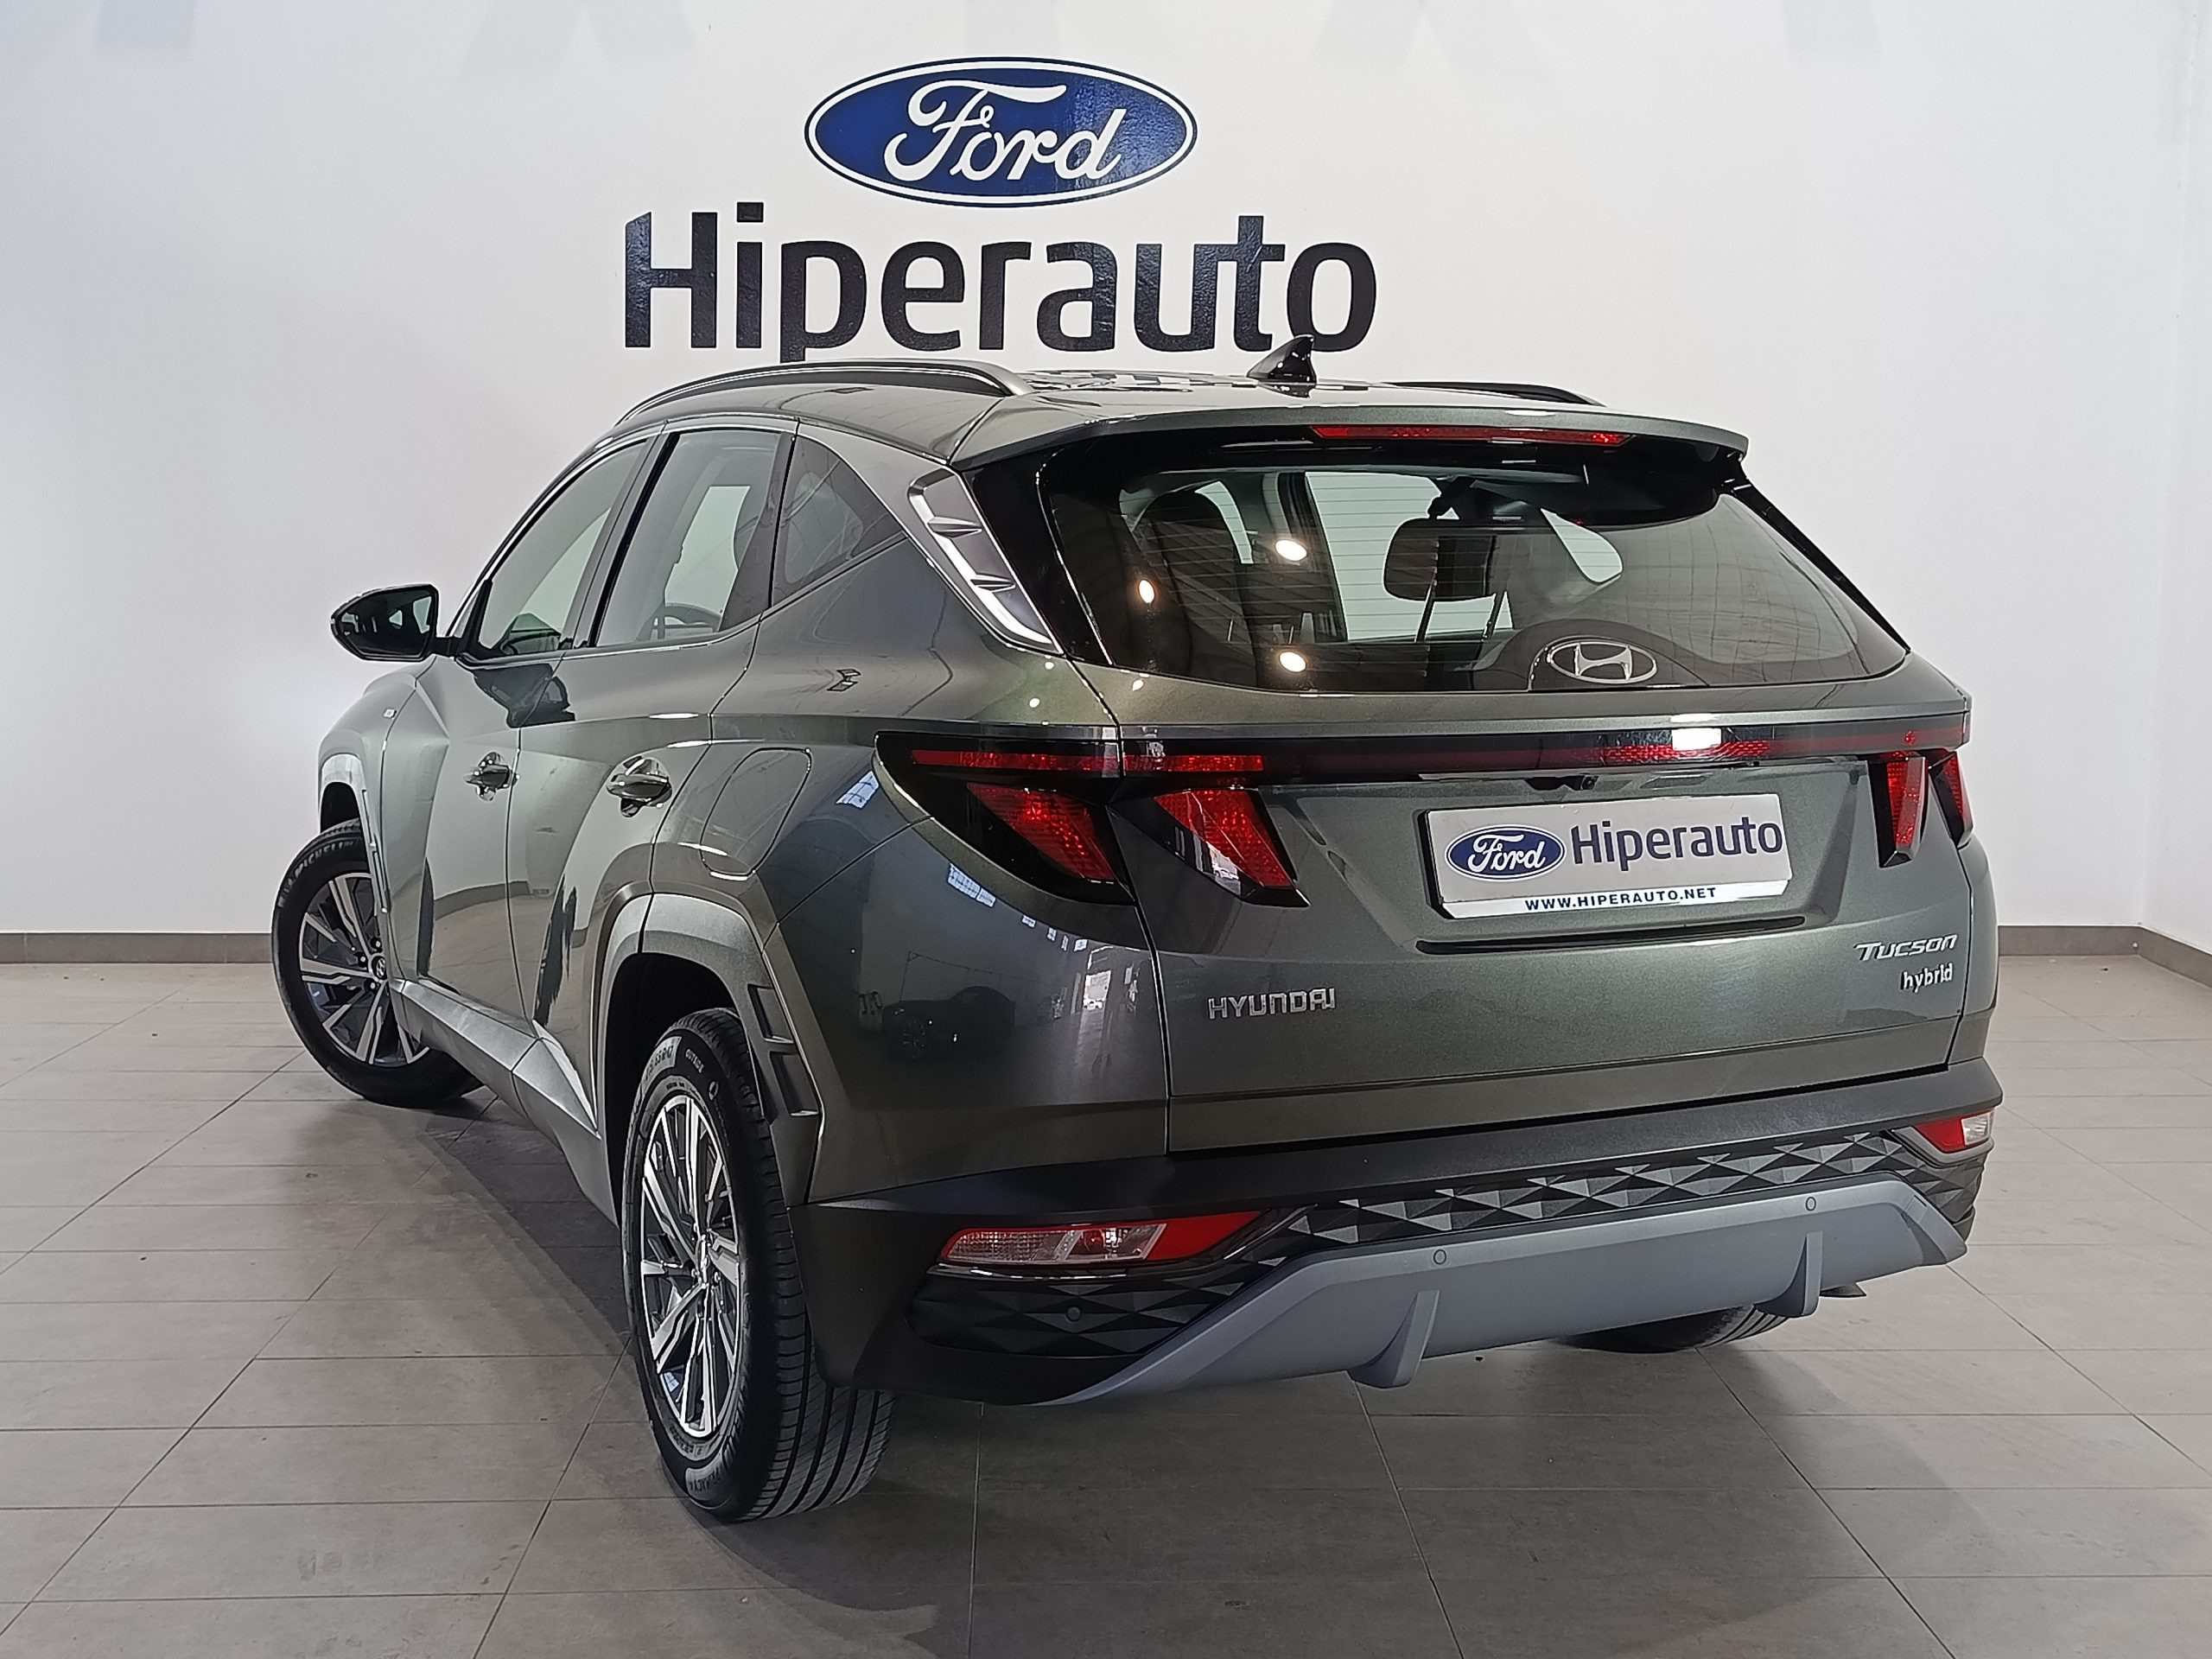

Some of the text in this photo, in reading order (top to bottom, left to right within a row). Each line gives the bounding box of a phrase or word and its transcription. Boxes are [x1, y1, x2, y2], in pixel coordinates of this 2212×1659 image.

[883, 79, 1127, 181] Ford
[625, 202, 1376, 363] Hiperauto
[1467, 817, 1783, 874] Ford Hiperauto
[1524, 887, 1717, 912] WWW.HIPERAUTO.NET
[1901, 963, 1954, 993] hybrid
[1208, 988, 1336, 1020] HYUNDAI
